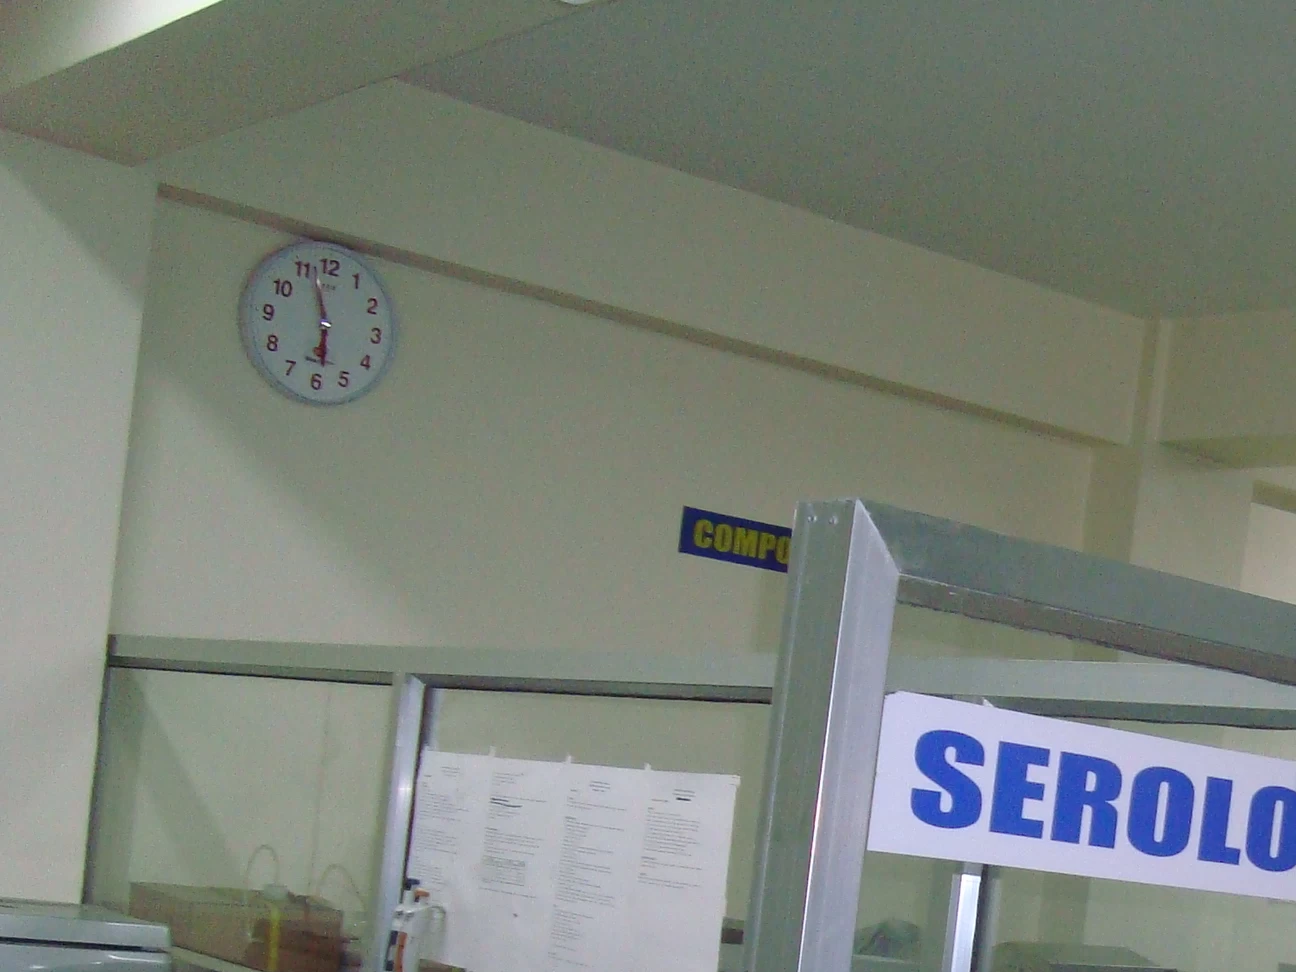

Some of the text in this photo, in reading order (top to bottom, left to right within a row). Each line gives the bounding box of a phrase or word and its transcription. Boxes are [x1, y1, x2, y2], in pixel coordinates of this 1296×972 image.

[294, 261, 311, 278] 11
[319, 258, 340, 277] 12
[273, 278, 293, 297] 10
[352, 273, 360, 289] 1
[262, 303, 275, 321] 9
[367, 298, 378, 315] 2
[266, 335, 279, 351] 8
[370, 327, 382, 344] 3
[285, 359, 297, 376] 7
[360, 354, 371, 370] 4
[310, 373, 323, 390] 6
[337, 371, 350, 387] 5
